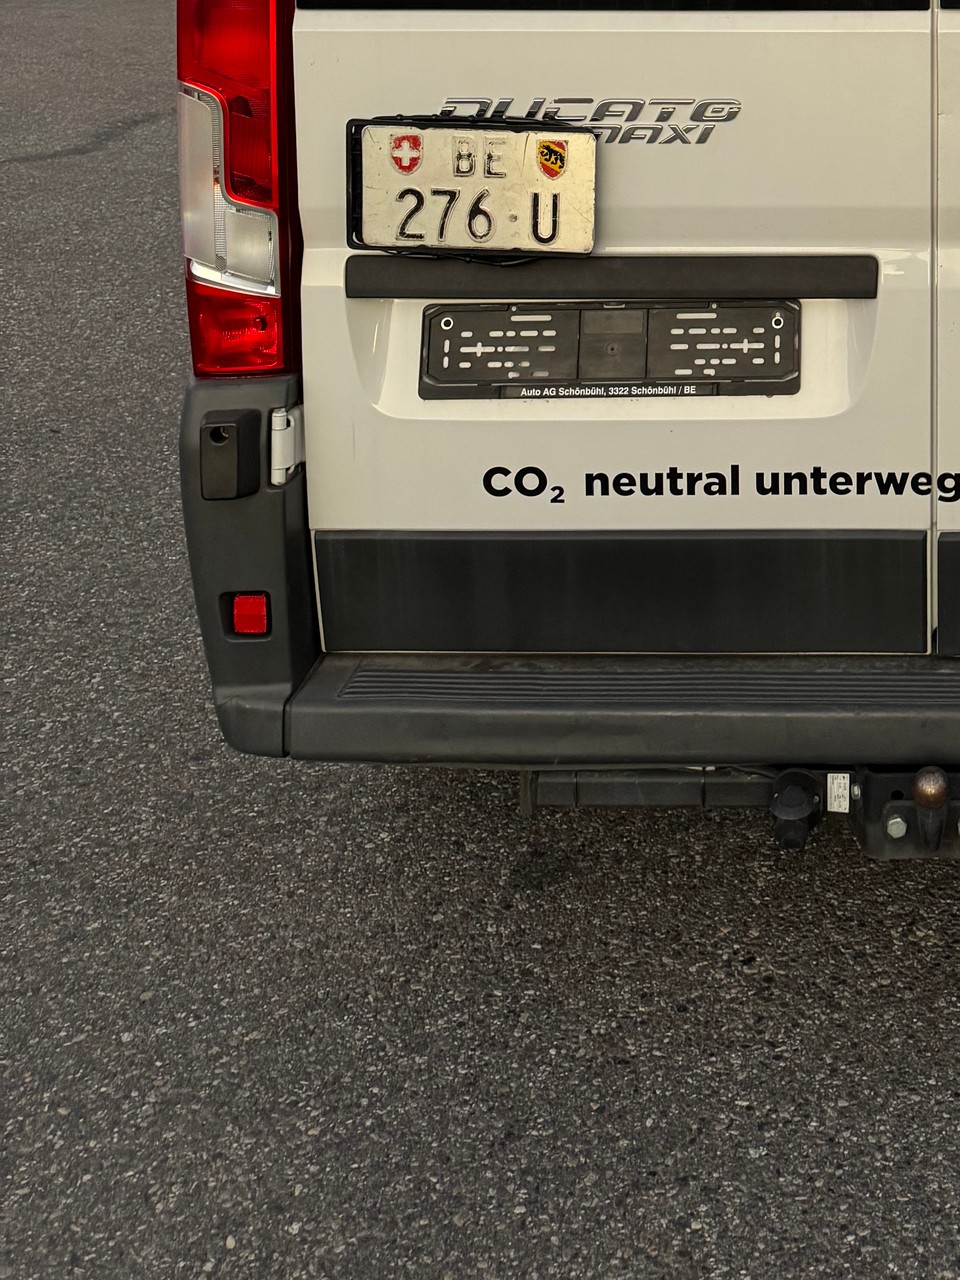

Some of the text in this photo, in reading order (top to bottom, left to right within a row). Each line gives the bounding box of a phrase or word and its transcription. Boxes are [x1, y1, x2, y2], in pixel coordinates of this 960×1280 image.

[439, 97, 742, 123] DUCATO
[451, 134, 508, 179] BE
[394, 187, 561, 246] 276 U
[520, 388, 541, 397] Auto
[542, 387, 556, 396] AG
[558, 386, 607, 397] Schönbühl,
[608, 386, 629, 396] 3322
[631, 385, 676, 396] Schönbühl
[683, 385, 697, 395] BE
[584, 464, 740, 497] neutral
